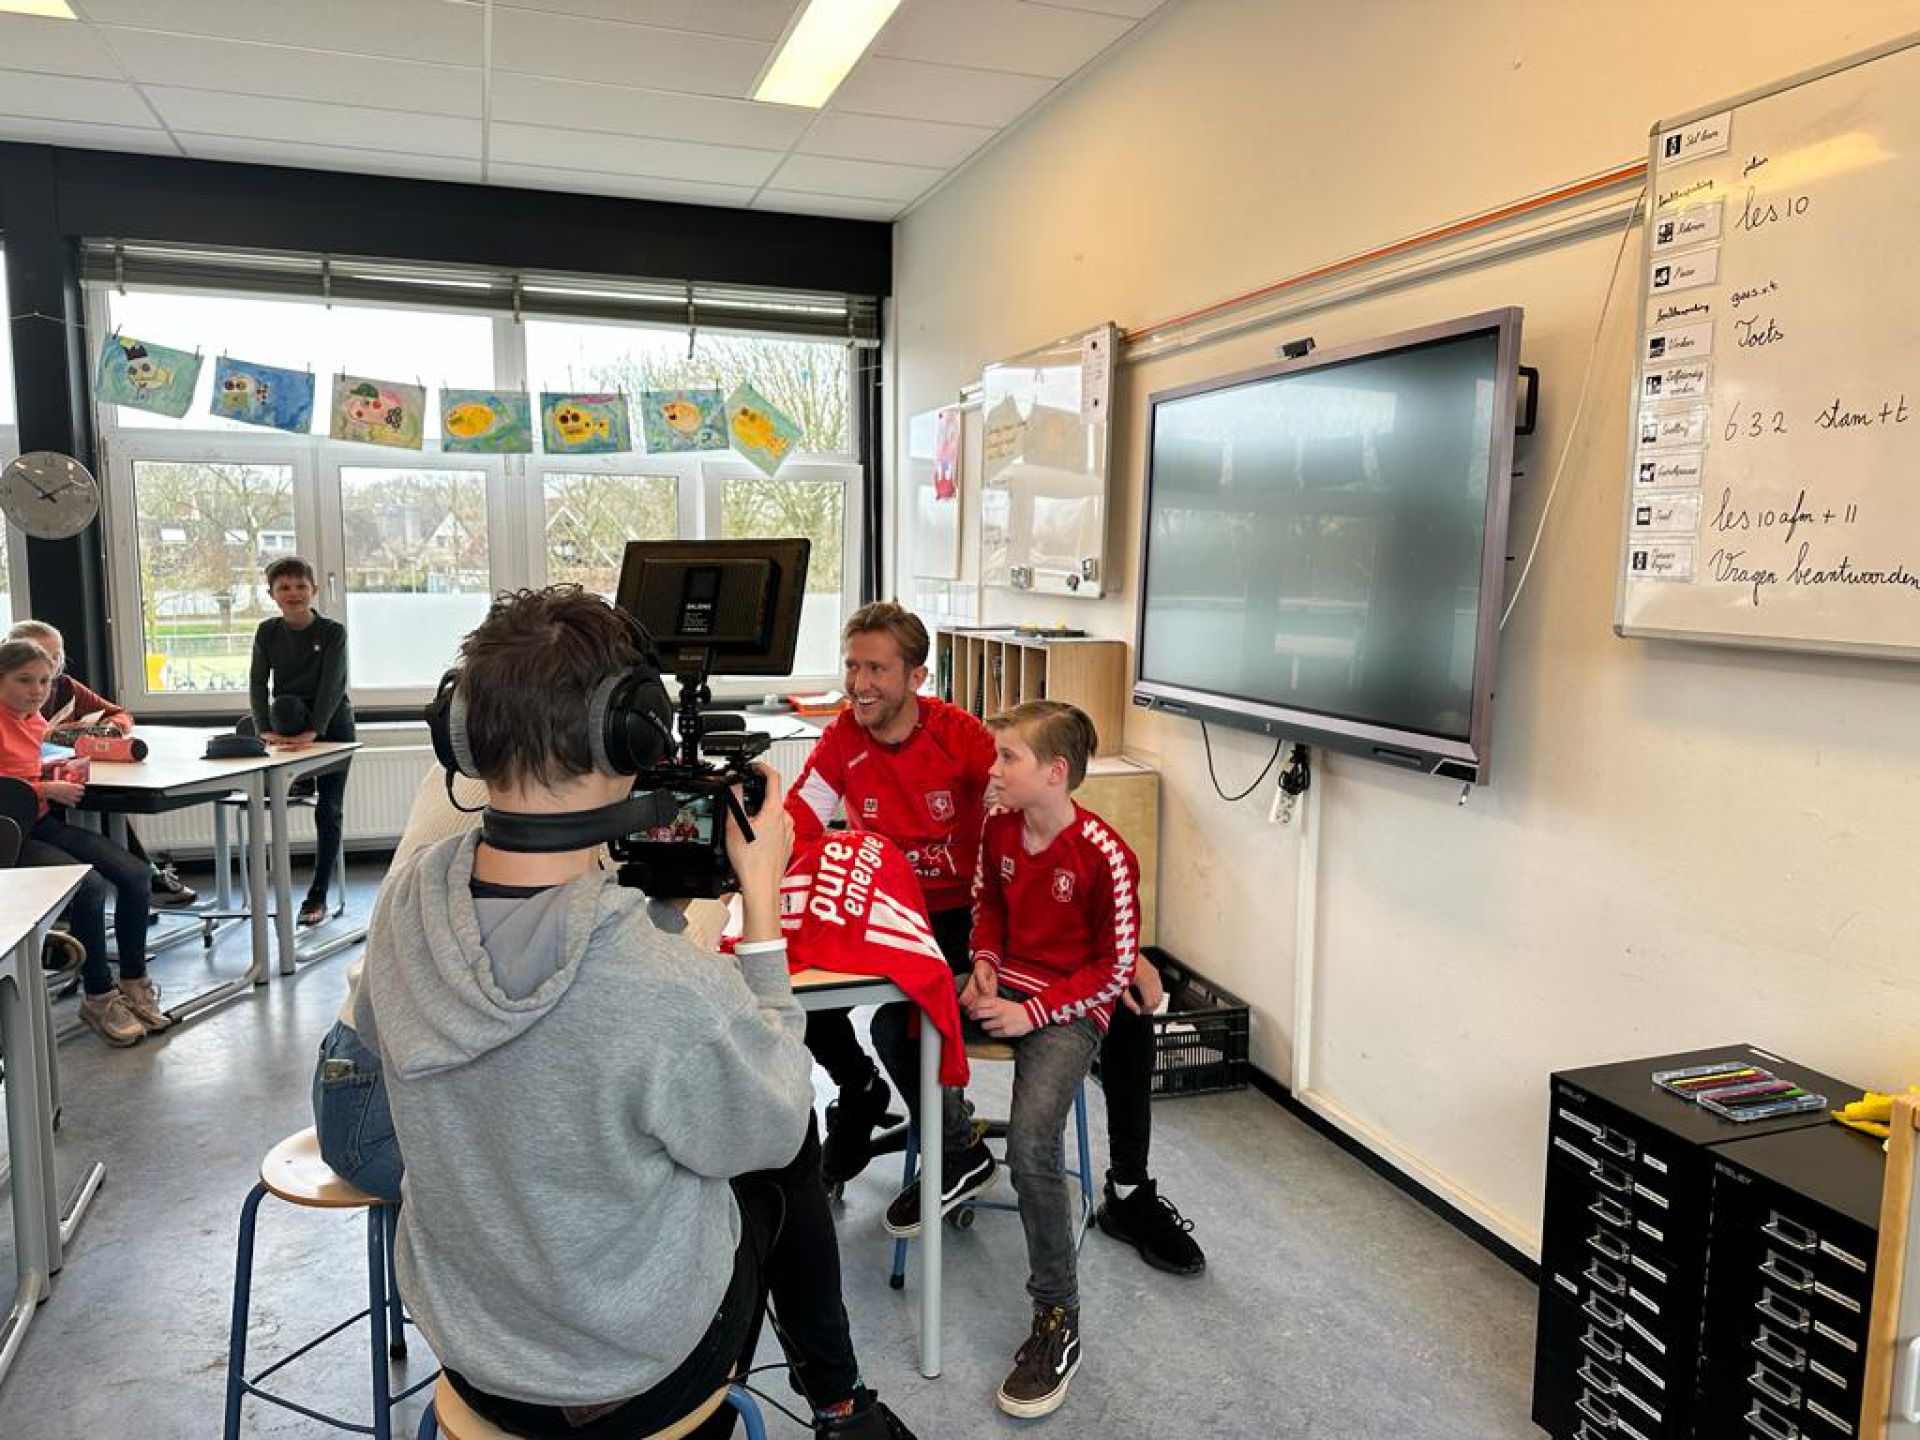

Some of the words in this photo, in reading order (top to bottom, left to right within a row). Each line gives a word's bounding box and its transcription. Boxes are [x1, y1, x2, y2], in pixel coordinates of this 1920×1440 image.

[1735, 186, 1778, 231] les
[1786, 196, 1810, 218] 10
[1734, 315, 1784, 347] Toets
[1815, 398, 1873, 428] stam
[1710, 487, 1750, 532] les
[1758, 511, 1775, 527] 10
[1708, 549, 1777, 606] Vragen
[1787, 541, 1920, 589] beantwoorden
[810, 842, 853, 926] pure
[843, 835, 884, 917] energie
